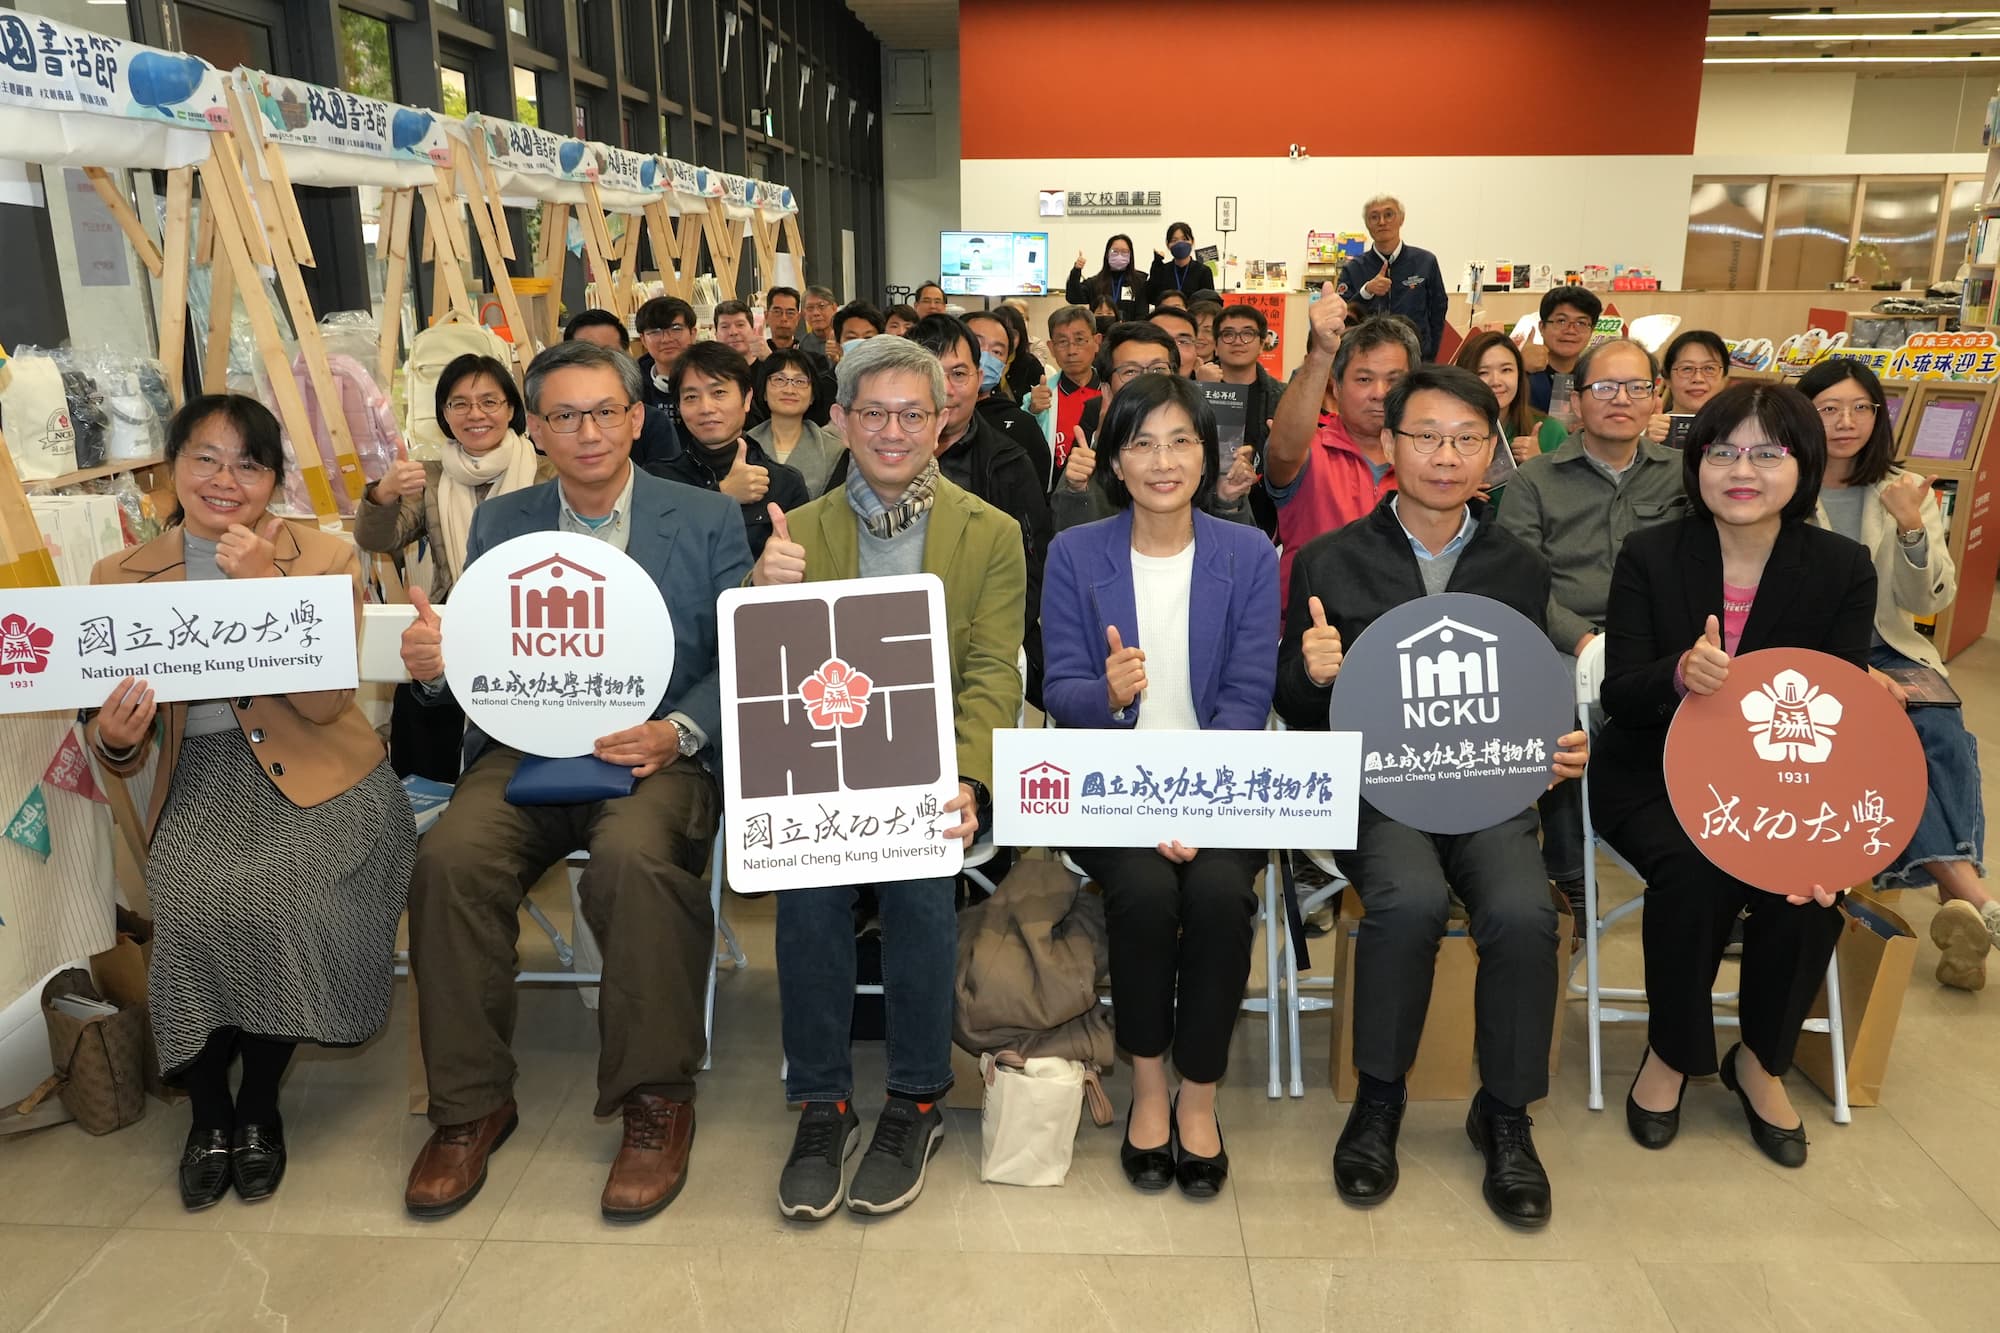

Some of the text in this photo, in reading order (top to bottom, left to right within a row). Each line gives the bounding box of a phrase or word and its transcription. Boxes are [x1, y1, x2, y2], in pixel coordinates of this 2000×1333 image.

[1067, 191, 1161, 206] 麗文校園書局
[1091, 208, 1120, 216] Campus
[1122, 208, 1161, 216] Bookstore
[1892, 353, 1997, 373] 小琉球迎王
[78, 599, 323, 657] 國立成功大學
[511, 632, 604, 658] NCKU
[81, 653, 324, 680] National Cheng Kung University
[9, 680, 34, 689] 1931
[471, 670, 645, 698] 國立成功大學博物館
[471, 697, 646, 708] National Cheng Kung University Museum
[1403, 697, 1500, 729] NCKU
[1364, 738, 1546, 772] 國立成功大學博物館
[1081, 764, 1333, 804] 國立成功大學博物館
[1365, 765, 1547, 785] National Cheng Kung University Museum
[1777, 771, 1811, 785] 1931
[1020, 801, 1070, 815] NCKU
[1081, 804, 1333, 819] National Cheng Kung University Museum
[1699, 783, 1895, 856] 成功大學
[743, 793, 944, 850] 國立成功大學
[743, 844, 947, 870] National Cheng Kung University
